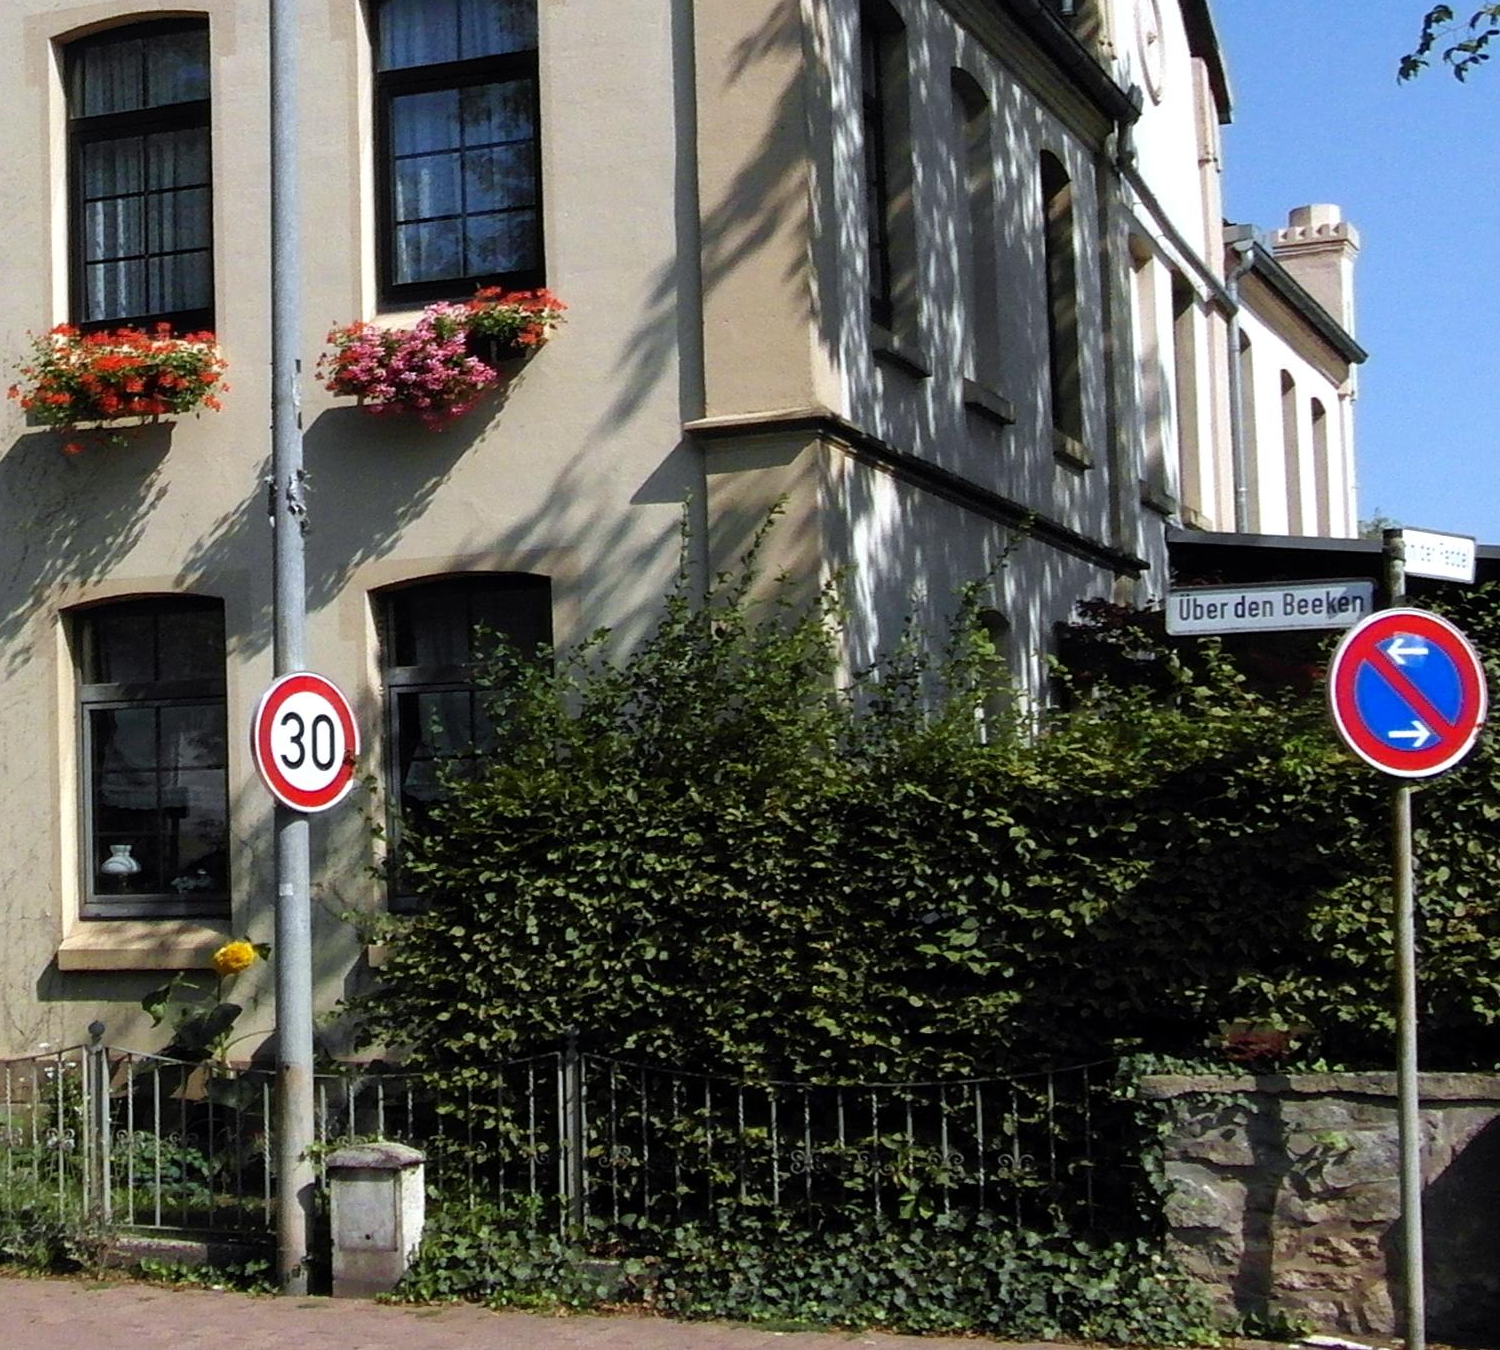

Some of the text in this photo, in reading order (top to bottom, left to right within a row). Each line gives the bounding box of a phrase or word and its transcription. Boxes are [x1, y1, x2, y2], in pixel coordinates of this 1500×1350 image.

[1179, 592, 1364, 621] Über den Beeken
[280, 711, 336, 771] 30
